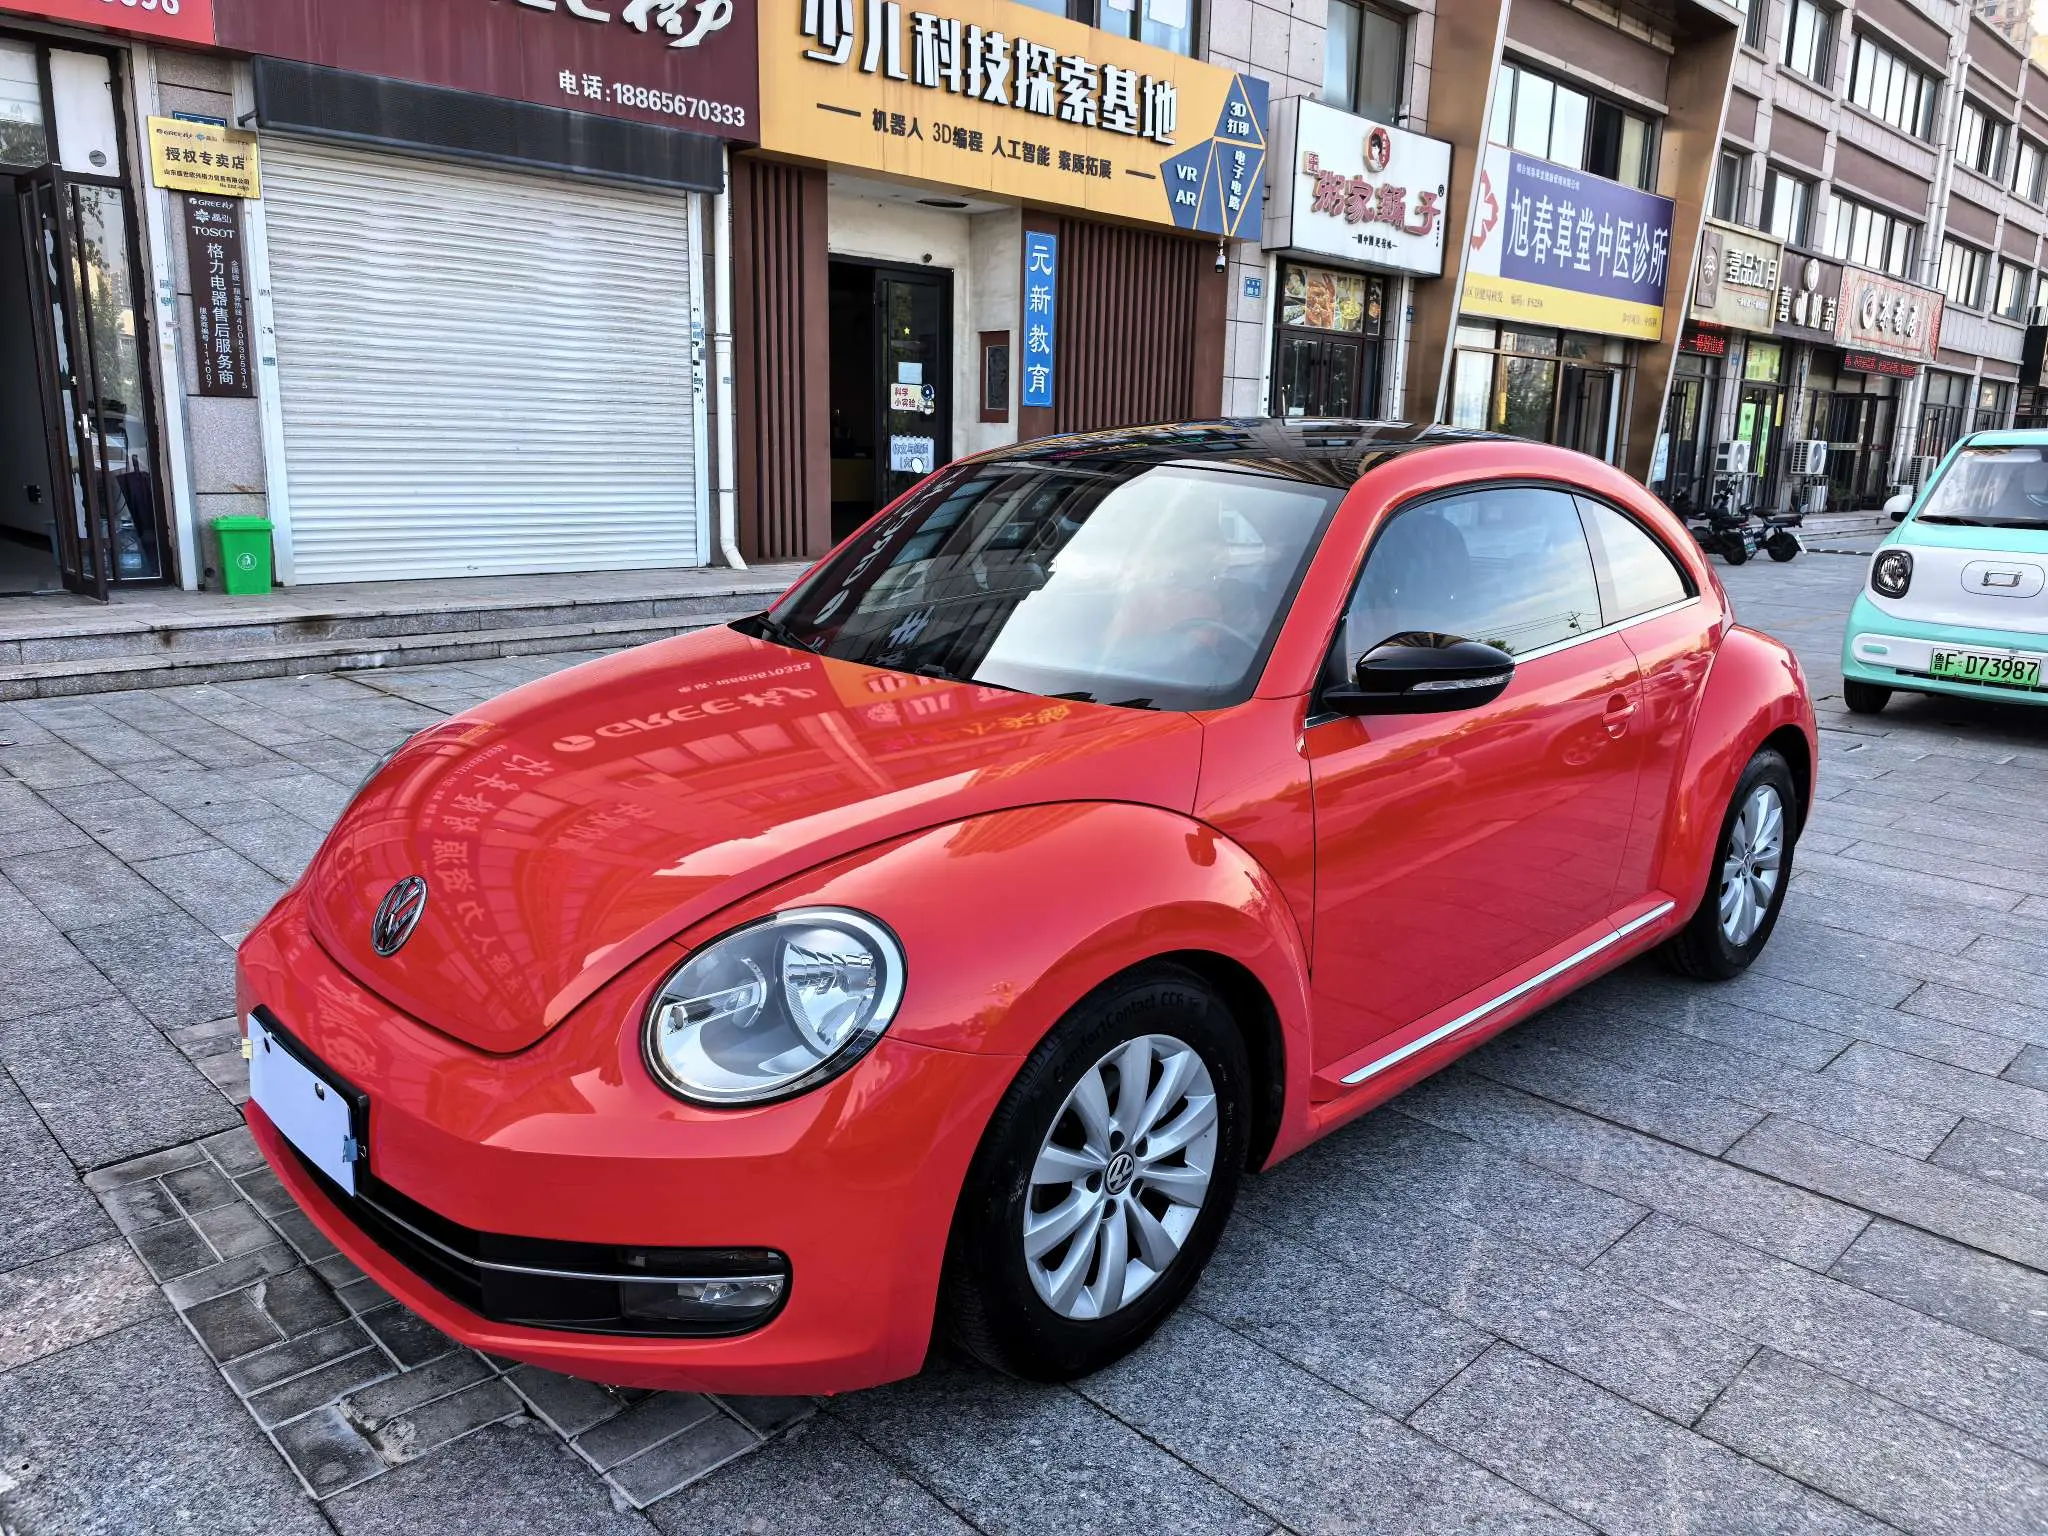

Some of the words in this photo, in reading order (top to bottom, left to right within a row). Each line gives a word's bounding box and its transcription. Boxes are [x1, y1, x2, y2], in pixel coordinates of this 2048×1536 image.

[803, 0, 1177, 145] 少儿科技探索基地
[559, 69, 745, 127] 电话:18865670333
[1230, 101, 1247, 118] 3D
[872, 108, 923, 141] 机器人
[932, 122, 984, 153] 3D编程
[991, 136, 1051, 167] 人工智能
[1057, 150, 1112, 180] 素质拓展
[1227, 118, 1250, 136] 打印
[165, 146, 245, 171] 授权专卖店
[1176, 163, 1198, 182] VR
[1228, 150, 1246, 211] 电子电路
[1175, 189, 1197, 206] AR
[192, 225, 235, 239] TOSOT
[1506, 187, 1669, 287] 旭春草堂中医诊所
[1726, 248, 1778, 291] 壹品江月
[207, 242, 234, 385] 格力电器售后服务商
[1028, 244, 1054, 396] 元新教育
